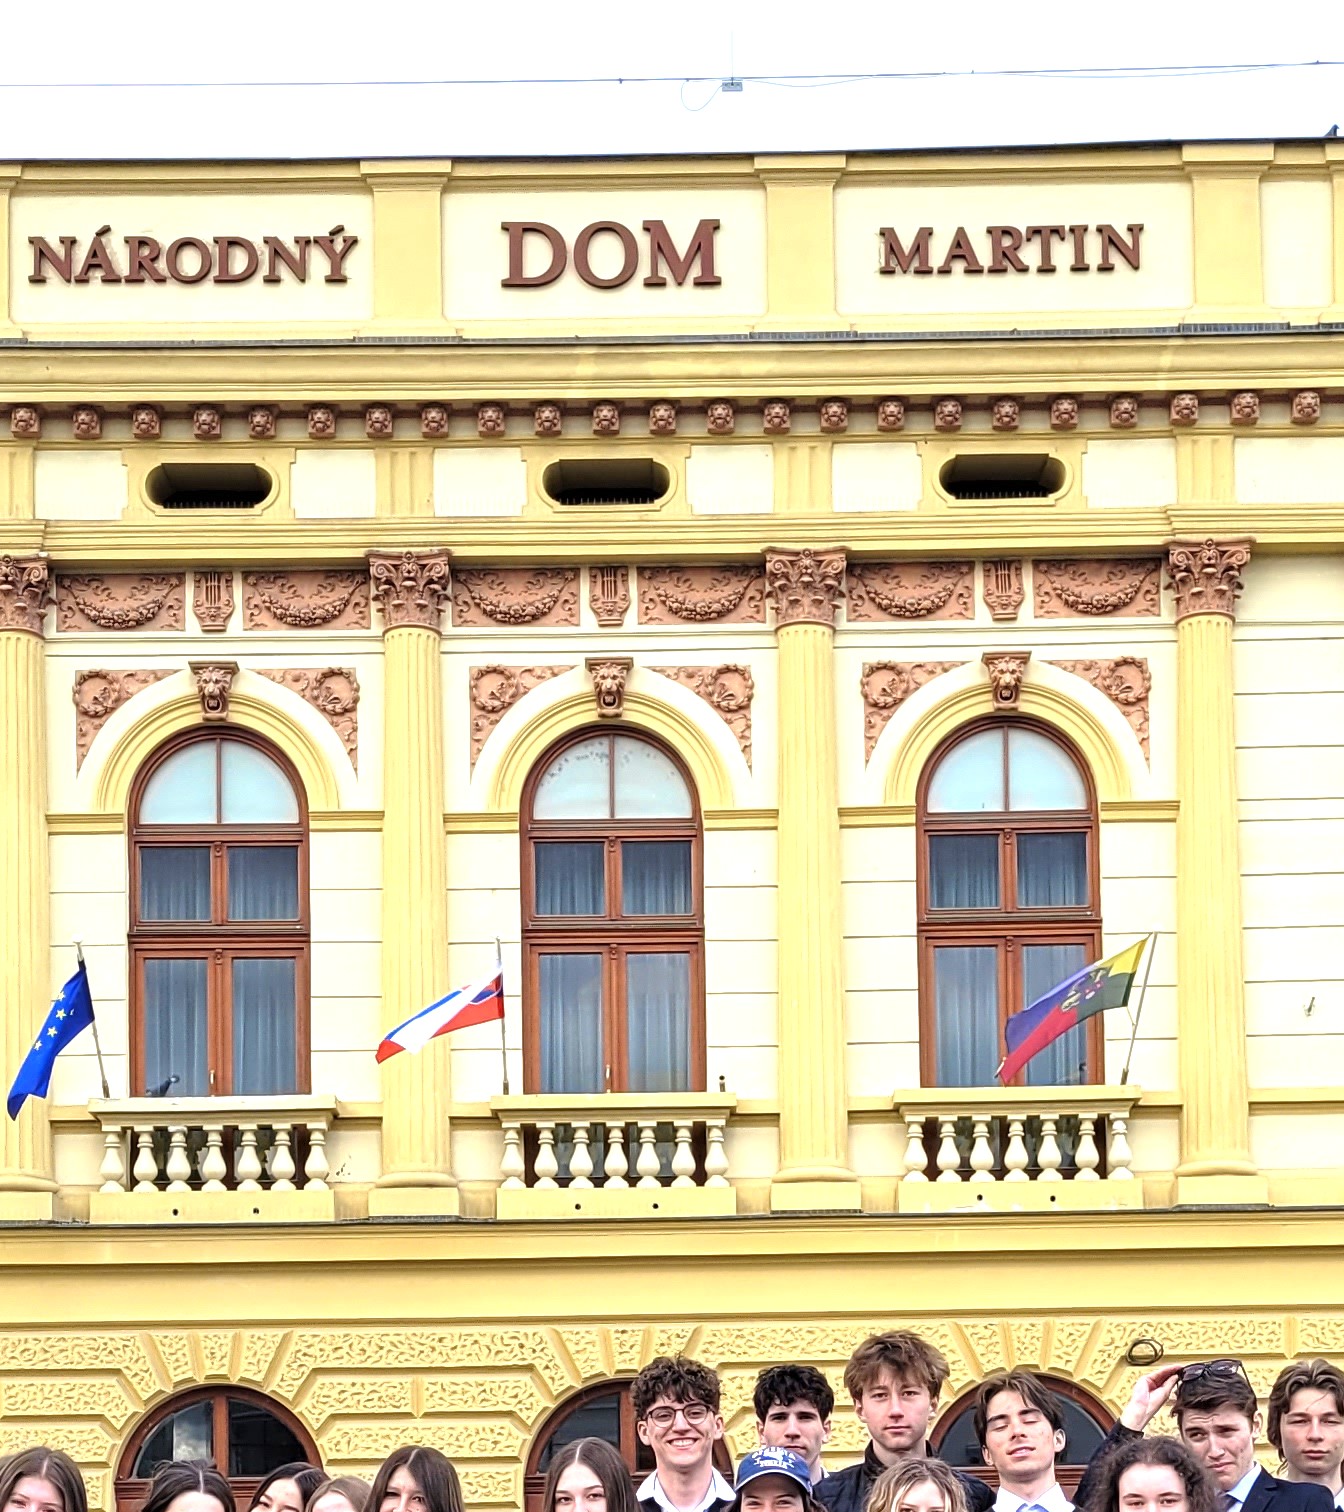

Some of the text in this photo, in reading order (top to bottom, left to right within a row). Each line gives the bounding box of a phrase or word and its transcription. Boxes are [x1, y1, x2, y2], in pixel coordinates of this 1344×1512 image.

[27, 218, 1145, 290] NÁRODNÝ DOM MARTIN
